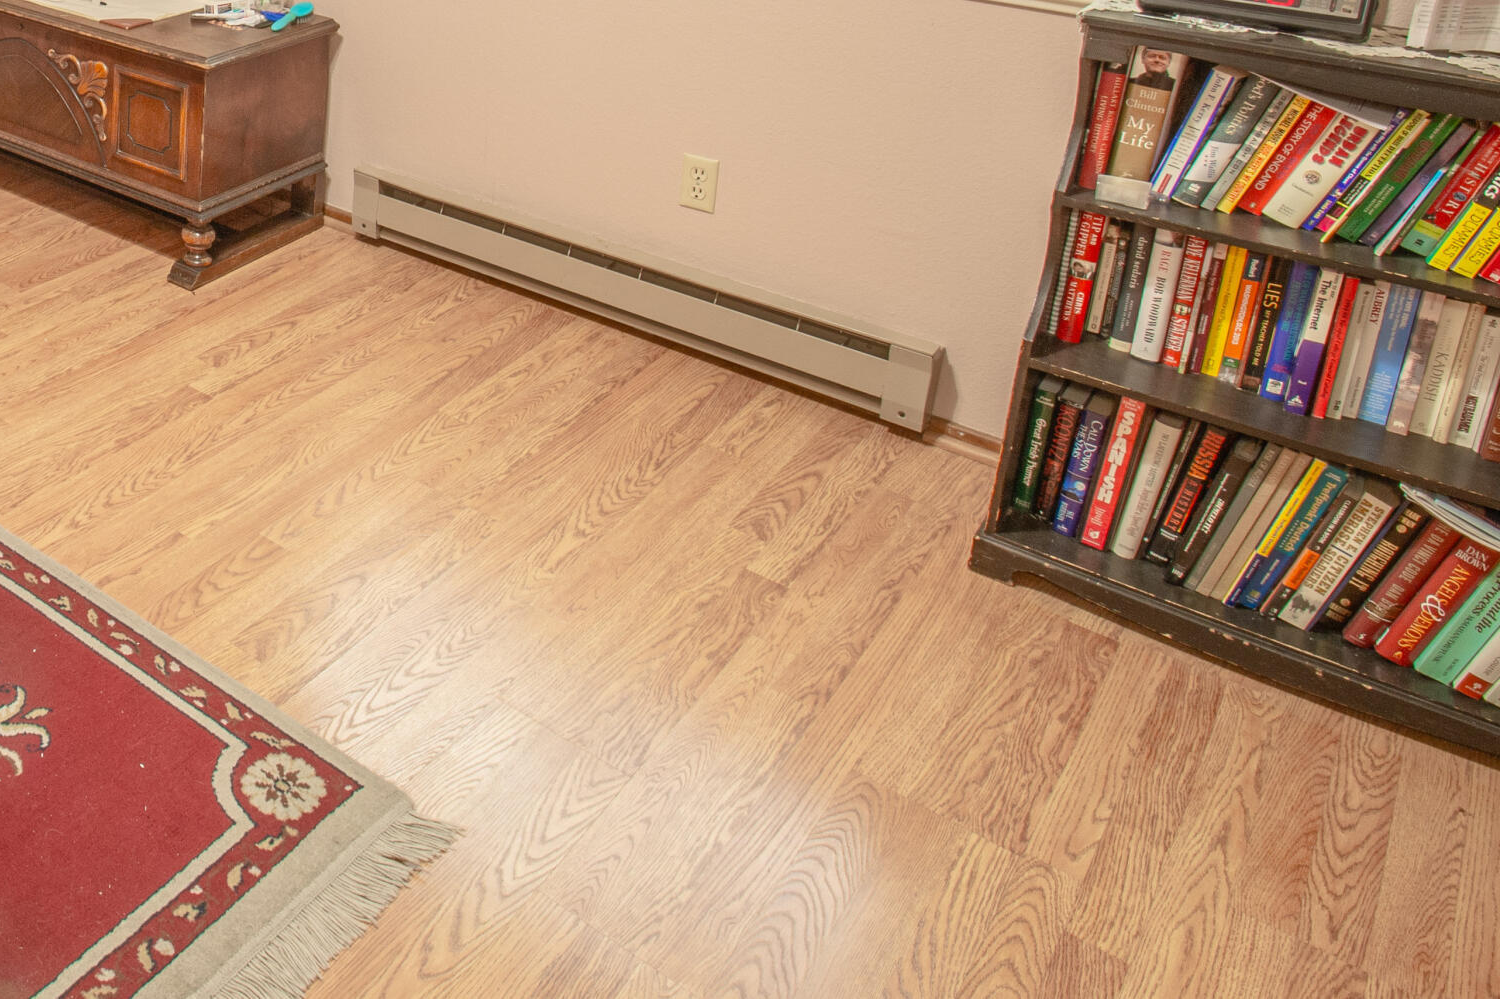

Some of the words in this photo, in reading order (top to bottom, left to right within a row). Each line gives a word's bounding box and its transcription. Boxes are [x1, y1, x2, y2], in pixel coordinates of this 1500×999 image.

[1109, 77, 1122, 108] HILLARY
[1139, 90, 1157, 99] Bill
[1210, 75, 1225, 92] John
[1248, 80, 1271, 101] od's
[1097, 95, 1109, 122] LIVING
[1125, 98, 1165, 114] Clinton
[1194, 102, 1210, 123] Kerry
[1306, 105, 1324, 123] THE
[1102, 111, 1116, 141] RODHAM
[1127, 115, 1155, 135] My
[1225, 102, 1257, 136] Politics
[1090, 124, 1103, 153] HISTORY
[1119, 131, 1153, 150] Life
[1289, 122, 1312, 144] STORY
[1310, 115, 1359, 164] LEGENDS
[1209, 146, 1219, 156] Jim
[1283, 143, 1295, 154] OF
[1328, 126, 1369, 168] URBAN
[1095, 144, 1109, 175] CLINTON
[1206, 157, 1217, 179] Wallis
[1254, 152, 1290, 191] ENGLAND
[1090, 216, 1104, 232] TIP
[1075, 221, 1091, 256] GIPPER
[1090, 233, 1098, 245] AND
[1187, 239, 1203, 256] FAYE
[1442, 214, 1483, 258] DUMMIES
[1135, 237, 1148, 259] david
[1158, 250, 1172, 272] RAGE
[1248, 259, 1258, 278] Fodor's
[1129, 261, 1143, 289] sedaris
[1154, 277, 1166, 294] BOB
[1176, 258, 1200, 302] KELLERMAN
[1263, 283, 1284, 308] LIES
[1318, 280, 1332, 295] The
[1062, 281, 1078, 321] MATTHEWS
[1074, 292, 1085, 314] CHRIS
[1368, 288, 1386, 325] AUBREY
[1143, 297, 1163, 343] WOODWARD
[1264, 310, 1271, 319] MY
[1308, 296, 1327, 331] Internet
[1166, 316, 1187, 352] STALKER
[1257, 320, 1269, 341] TEACHER
[1254, 342, 1264, 356] TOLD
[1252, 357, 1261, 366] ME
[1425, 351, 1448, 401] KADDISH
[1035, 418, 1046, 439] Great
[1049, 409, 1073, 461] KOONTZ
[1077, 425, 1087, 439] THE
[1089, 420, 1103, 443] CALL
[1029, 440, 1042, 459] Irish
[1071, 439, 1084, 459] STARS
[1079, 444, 1098, 472] DOWN
[1097, 411, 1136, 504] SPANISH
[1187, 430, 1226, 480] RUSSIA
[1167, 488, 1196, 532] HISTORY
[1303, 481, 1338, 521] Treffpunkt
[1331, 498, 1372, 547] AMBROSE
[1352, 506, 1386, 542] STEPHEN
[1284, 521, 1311, 552] Deutsch
[1431, 535, 1448, 546] DA
[1358, 539, 1399, 577] ROUGHING
[1417, 546, 1442, 566] VINCI
[1455, 549, 1487, 572] BROWN
[1466, 546, 1489, 563] DAN
[1303, 549, 1337, 588] SOLDIERS
[1314, 554, 1353, 596] CITIZEN
[1399, 567, 1424, 584] CODE
[1350, 577, 1369, 592] IT
[1431, 565, 1470, 605] ANGELS
[1420, 595, 1446, 620] &
[1397, 613, 1434, 649] DEMONS
[1475, 617, 1491, 634] the
